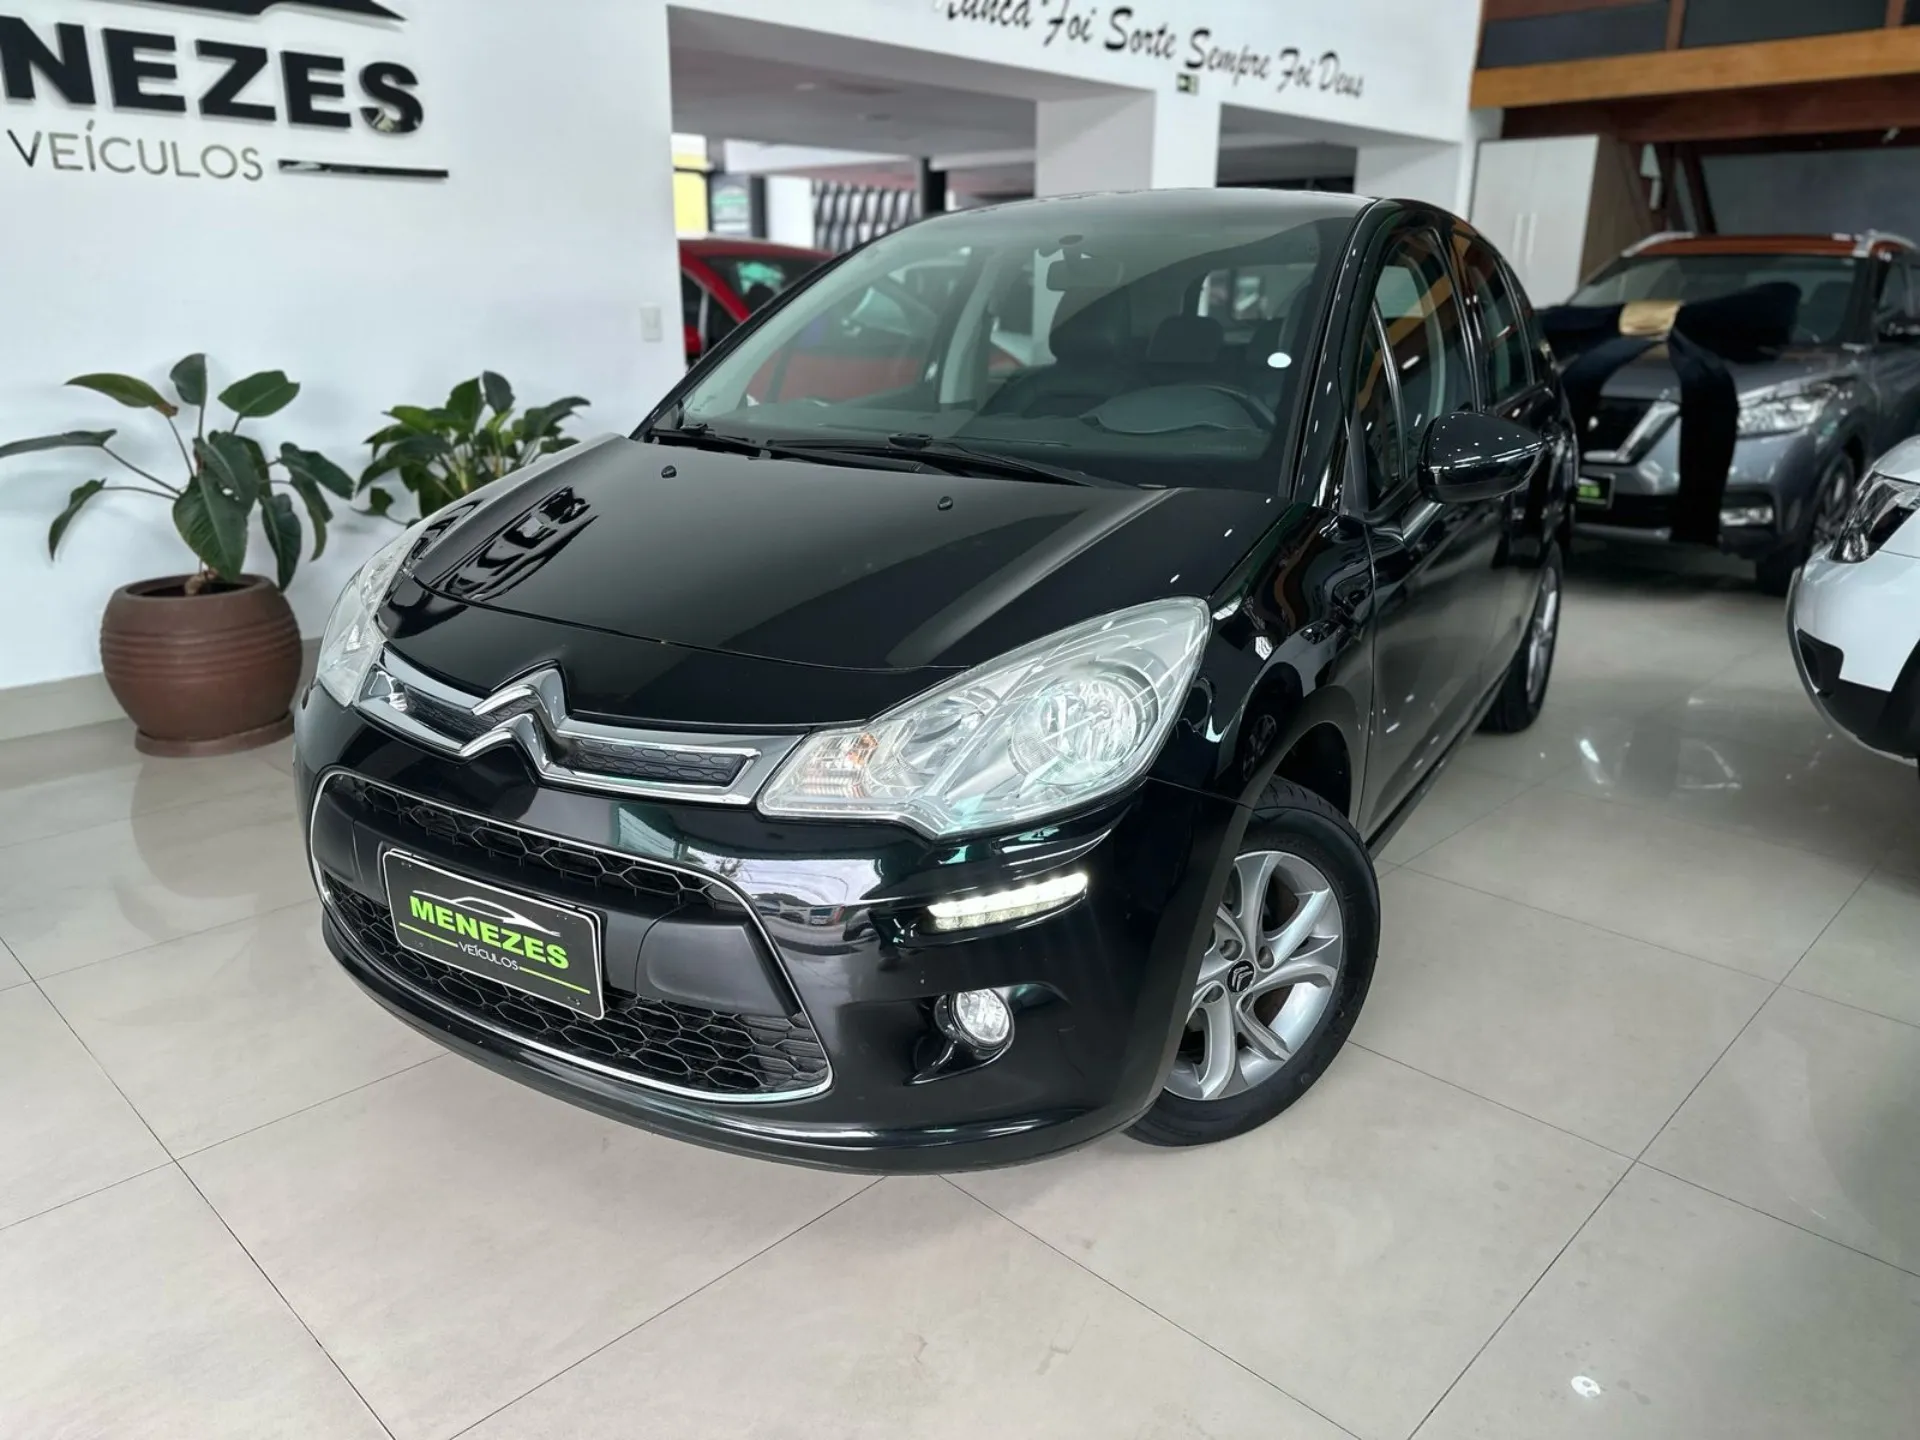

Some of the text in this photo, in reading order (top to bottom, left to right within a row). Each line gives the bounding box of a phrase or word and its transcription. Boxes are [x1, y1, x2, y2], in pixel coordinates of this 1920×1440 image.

[0, 15, 424, 134] NEZES
[1105, 7, 1177, 58] Sorte
[1185, 28, 1271, 87] Sempre
[1276, 47, 1317, 93] Foi
[1319, 51, 1364, 97] Deus
[7, 119, 264, 181] VEÍCULOS
[409, 895, 570, 970] MENEZES
[458, 941, 519, 971] VEÍCULOS
